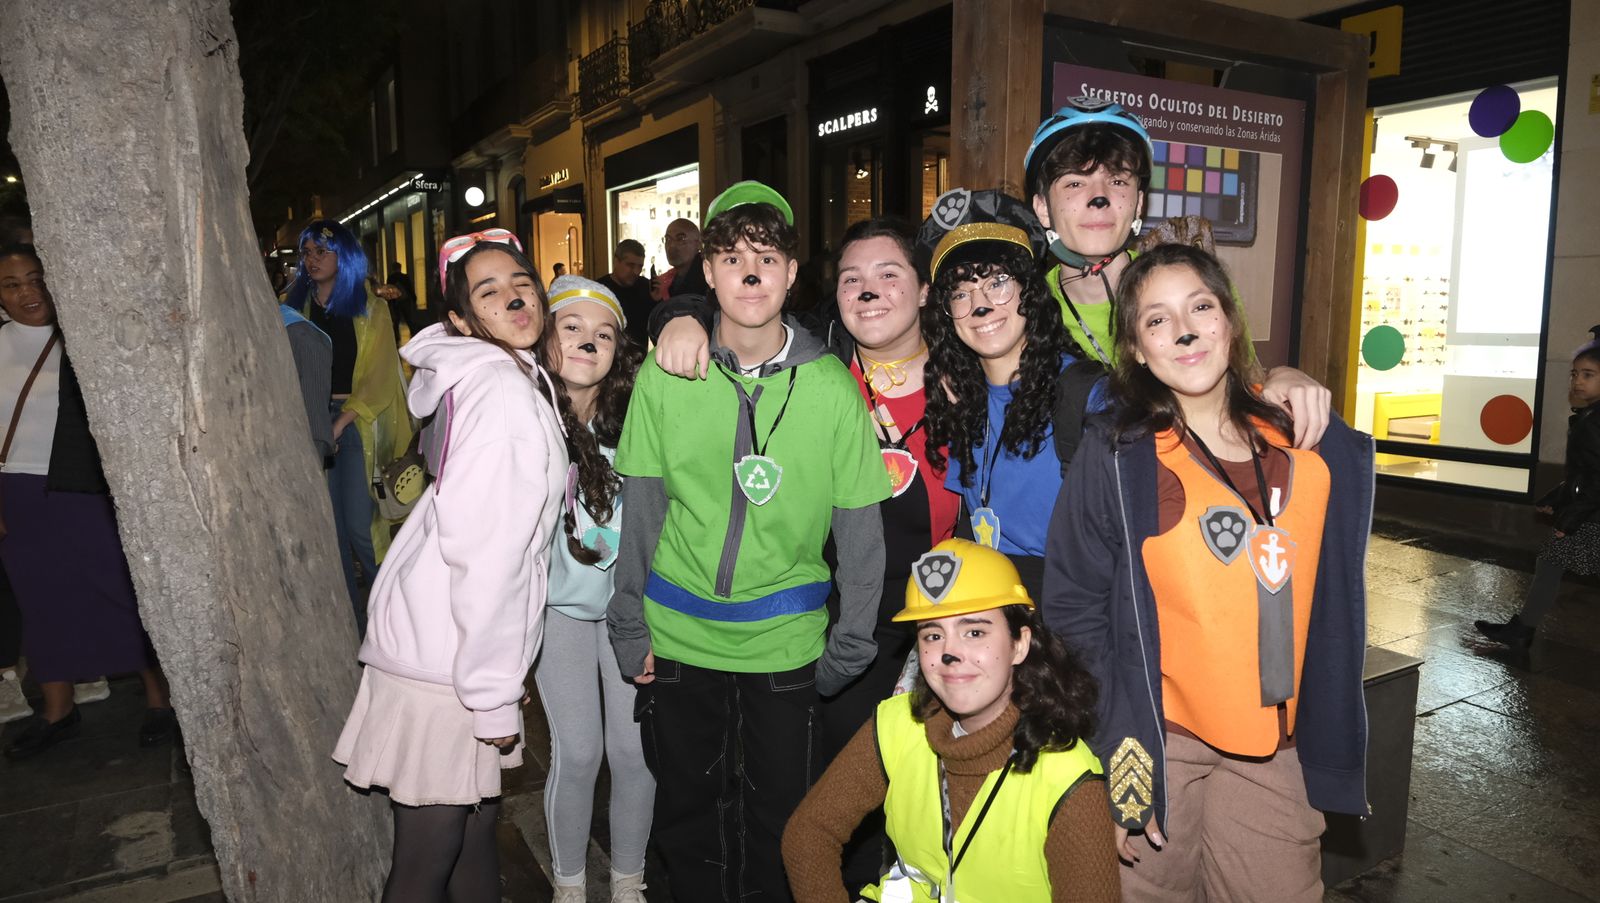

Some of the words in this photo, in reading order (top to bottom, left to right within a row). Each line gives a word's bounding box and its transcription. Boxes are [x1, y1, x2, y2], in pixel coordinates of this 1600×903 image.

[818, 107, 878, 137] SCALPERS
[1149, 93, 1203, 116] OCULTOS
[1208, 104, 1228, 120] DEL
[1232, 105, 1283, 127] DESIERTO
[1169, 121, 1175, 132] y
[1176, 122, 1224, 136] conservando
[1225, 125, 1236, 137] las
[1237, 127, 1258, 140] Zonas
[1259, 127, 1281, 143] Áridas
